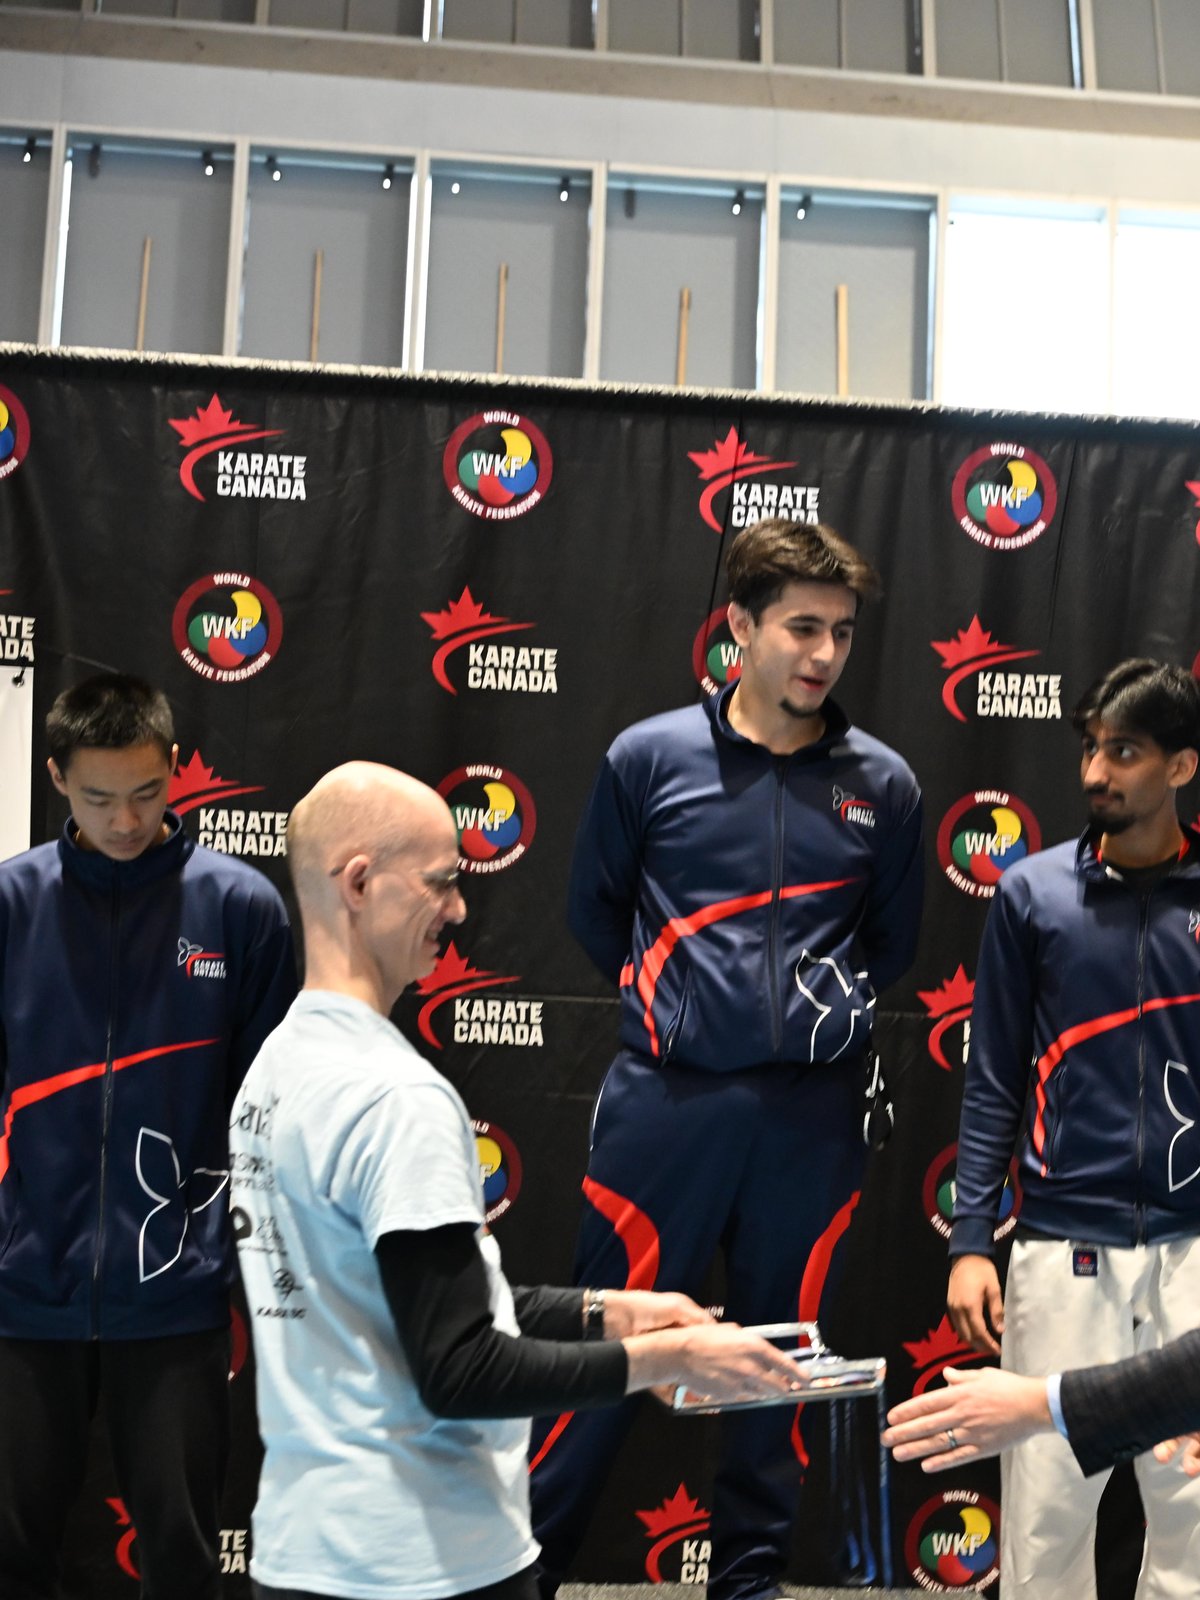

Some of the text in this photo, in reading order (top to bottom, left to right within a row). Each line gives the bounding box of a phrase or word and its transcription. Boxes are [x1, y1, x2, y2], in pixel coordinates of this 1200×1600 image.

[483, 410, 520, 427] WORLD
[990, 442, 1025, 459] WORLD
[218, 451, 307, 478] KARATE
[472, 452, 523, 478] WKF
[217, 474, 306, 501] CANADA
[733, 482, 820, 509] KARATE
[980, 484, 1028, 509] WKF
[451, 484, 541, 519] KARATE FEDERATION
[961, 515, 992, 547] KARATE
[213, 572, 251, 587] WORLD
[0, 614, 36, 640] ATE
[202, 615, 253, 640] WKF
[181, 647, 271, 681] KARATE FEDERATION
[469, 643, 558, 671] KARATE
[468, 666, 558, 693] CANADA
[978, 671, 1062, 697] KARATE
[977, 694, 1062, 719] CANADA
[466, 765, 503, 780] WORLD
[974, 790, 1010, 805] WORLD
[199, 808, 289, 834] KARATE
[456, 807, 507, 831] WKF
[199, 831, 288, 857] CANADA
[965, 832, 1013, 856] WKF
[945, 864, 976, 895] KARATE
[455, 998, 544, 1024] KARATE
[454, 1021, 544, 1047] CANADA
[942, 1490, 979, 1504] WORLD
[932, 1532, 983, 1556] WKF
